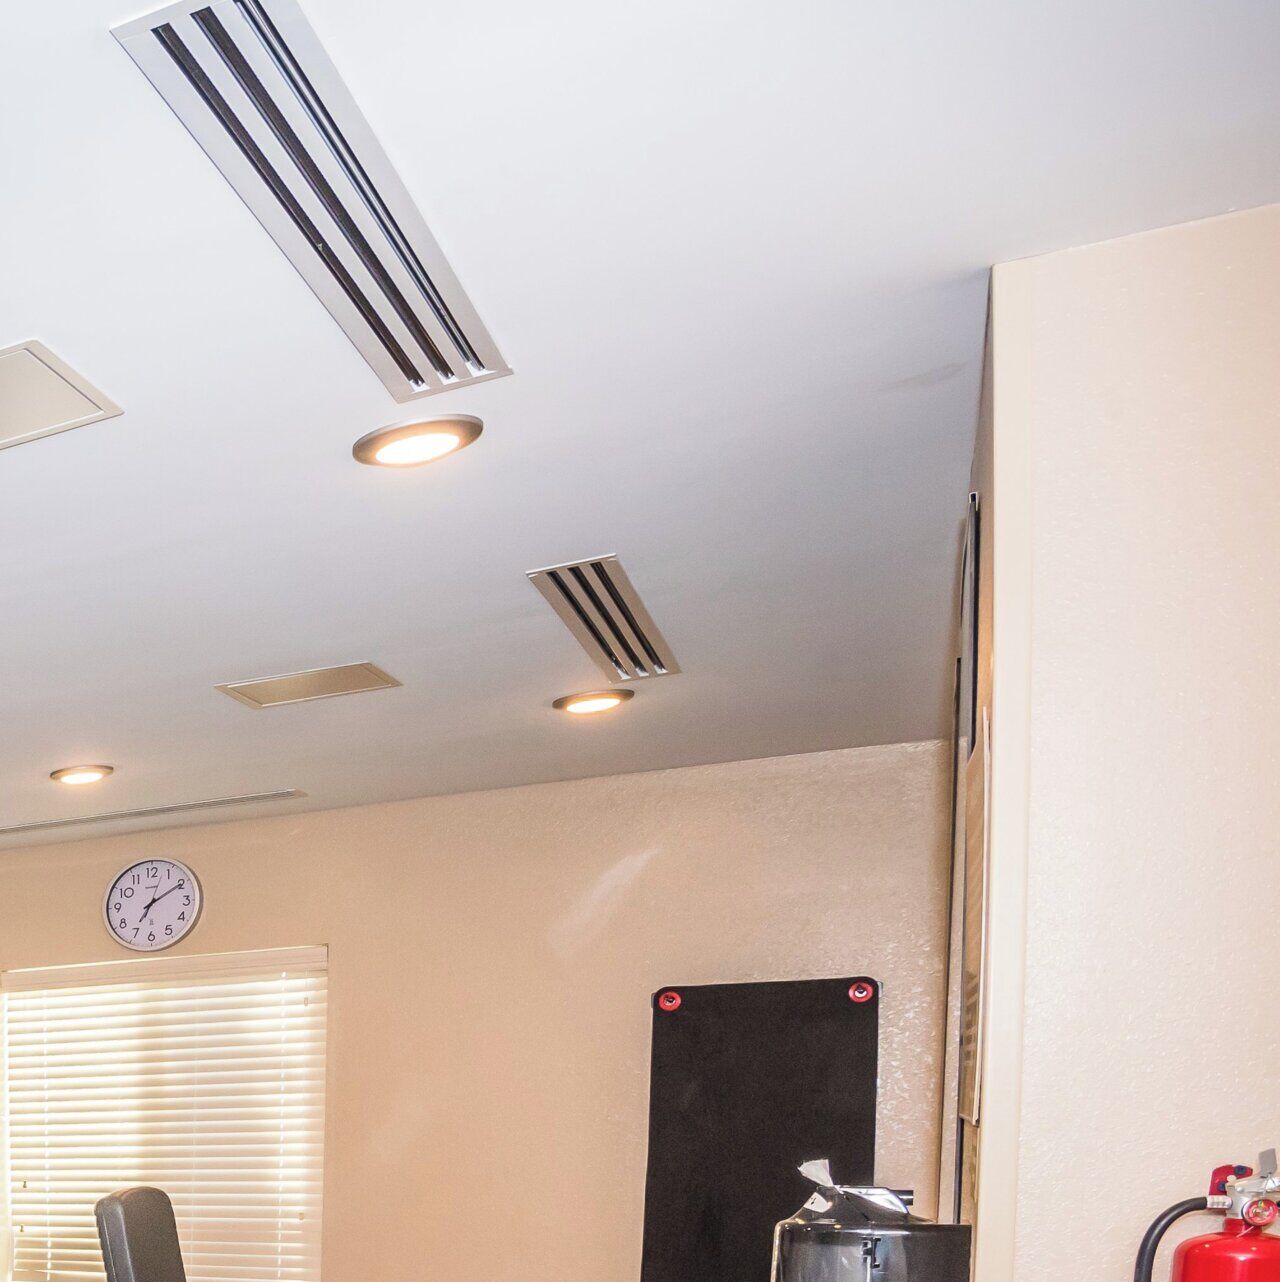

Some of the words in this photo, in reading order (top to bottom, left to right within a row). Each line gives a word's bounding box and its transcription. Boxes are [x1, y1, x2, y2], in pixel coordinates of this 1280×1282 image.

[146, 867, 158, 878] 12
[132, 874, 140, 885] 11
[177, 878, 185, 889] 2
[120, 887, 134, 898] 10
[182, 895, 191, 906] 3
[114, 902, 122, 913] 9
[177, 911, 185, 921] 4
[119, 918, 127, 929] 8
[132, 927, 140, 938] 7
[164, 925, 173, 935] 5
[147, 931, 156, 942] 6
